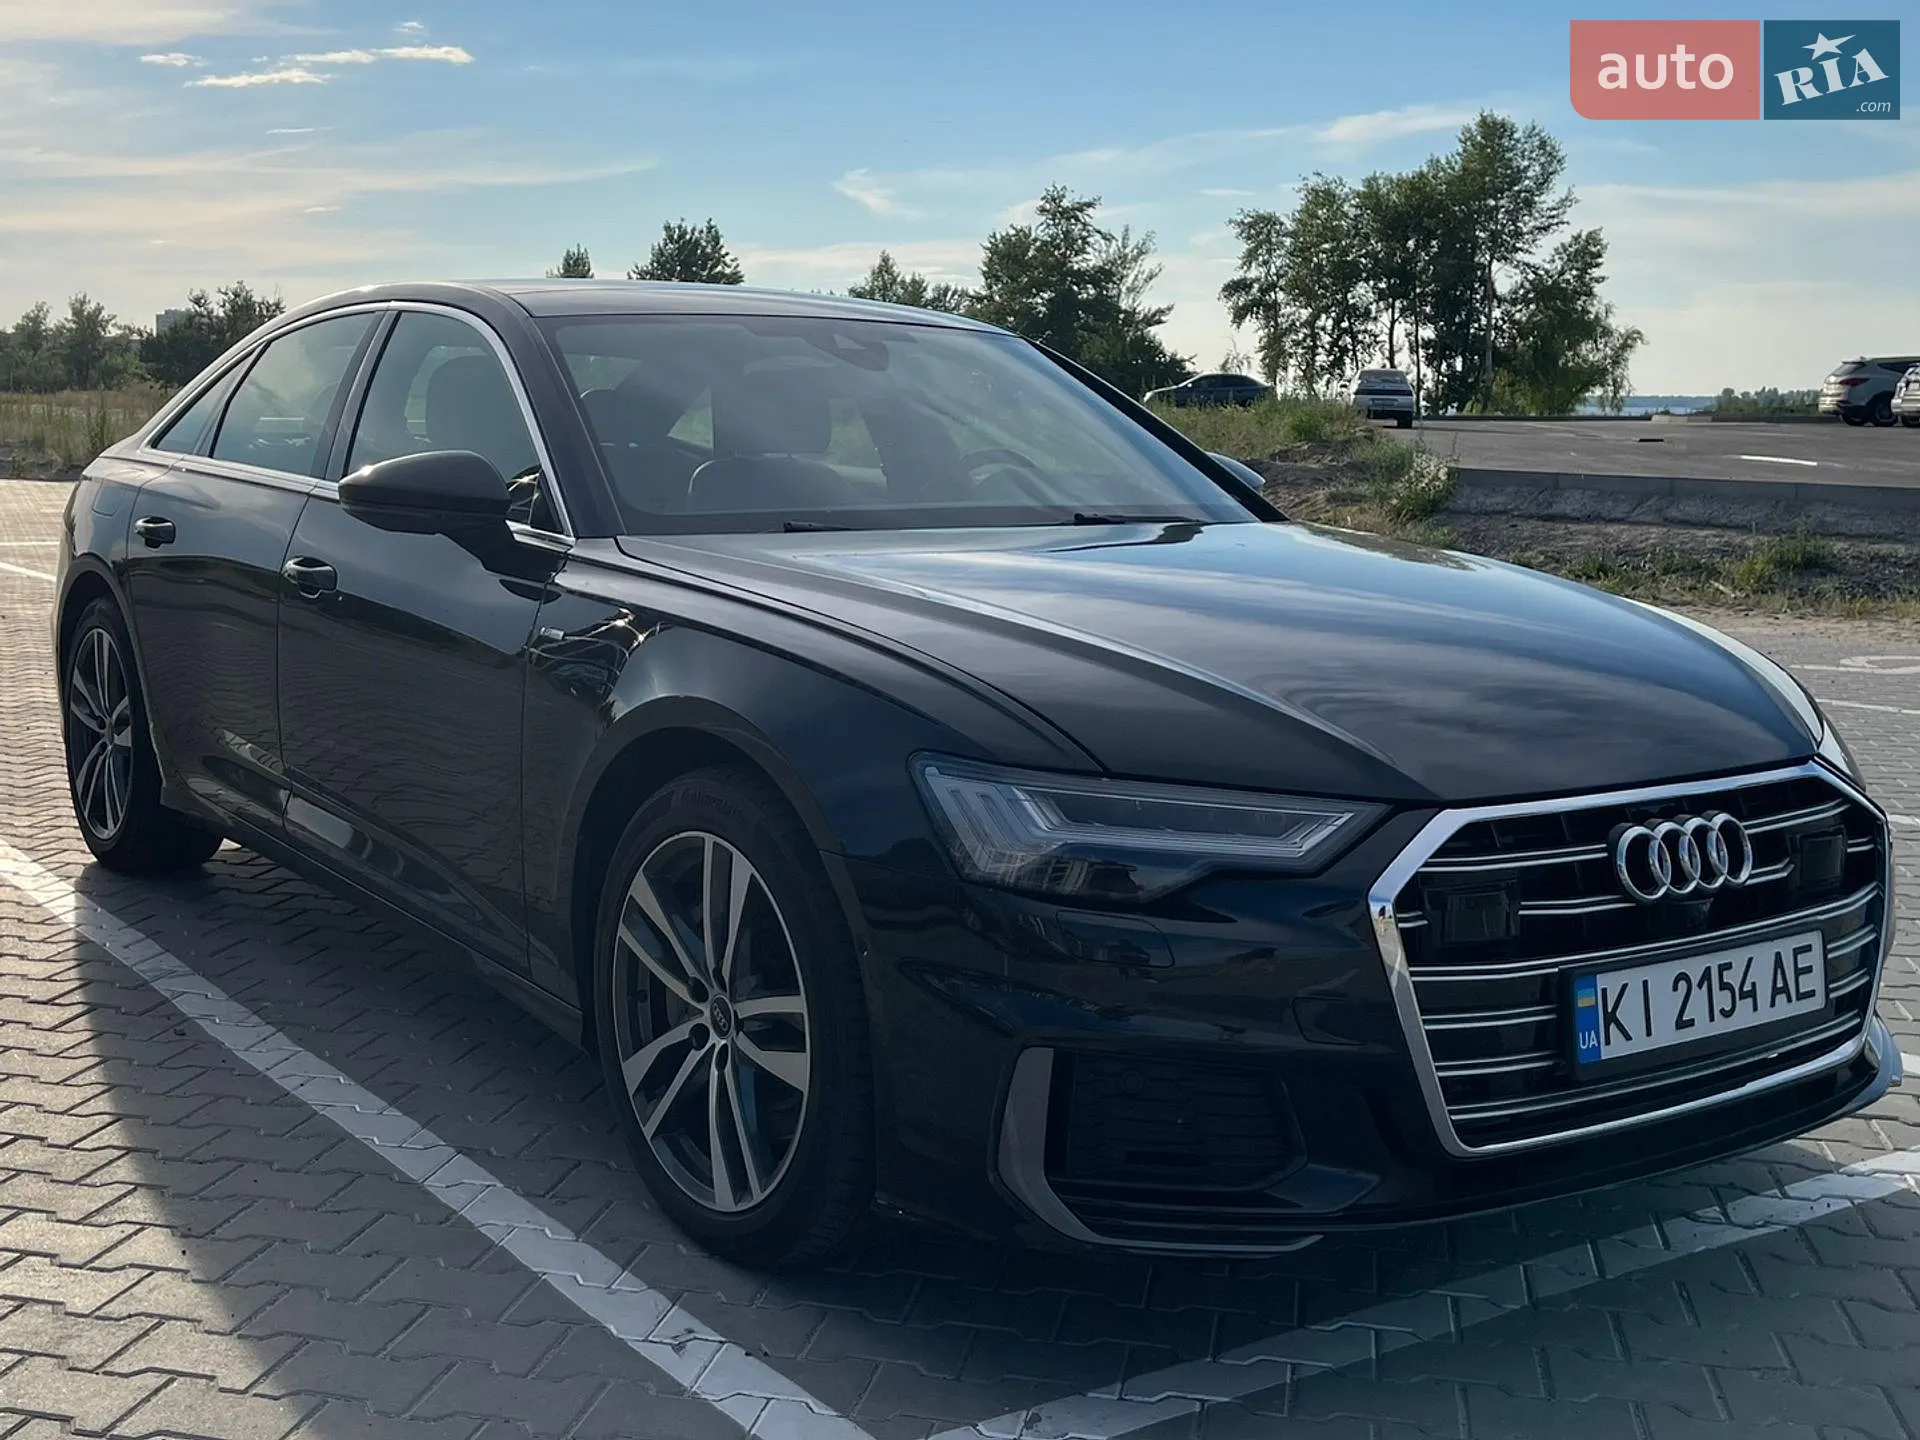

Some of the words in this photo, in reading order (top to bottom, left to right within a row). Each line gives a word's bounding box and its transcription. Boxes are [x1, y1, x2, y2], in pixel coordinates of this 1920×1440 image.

[1601, 978, 1653, 1046] KI
[1671, 956, 1759, 1032] 2154
[1769, 943, 1817, 1009] AE
[1578, 1030, 1599, 1050] UA
